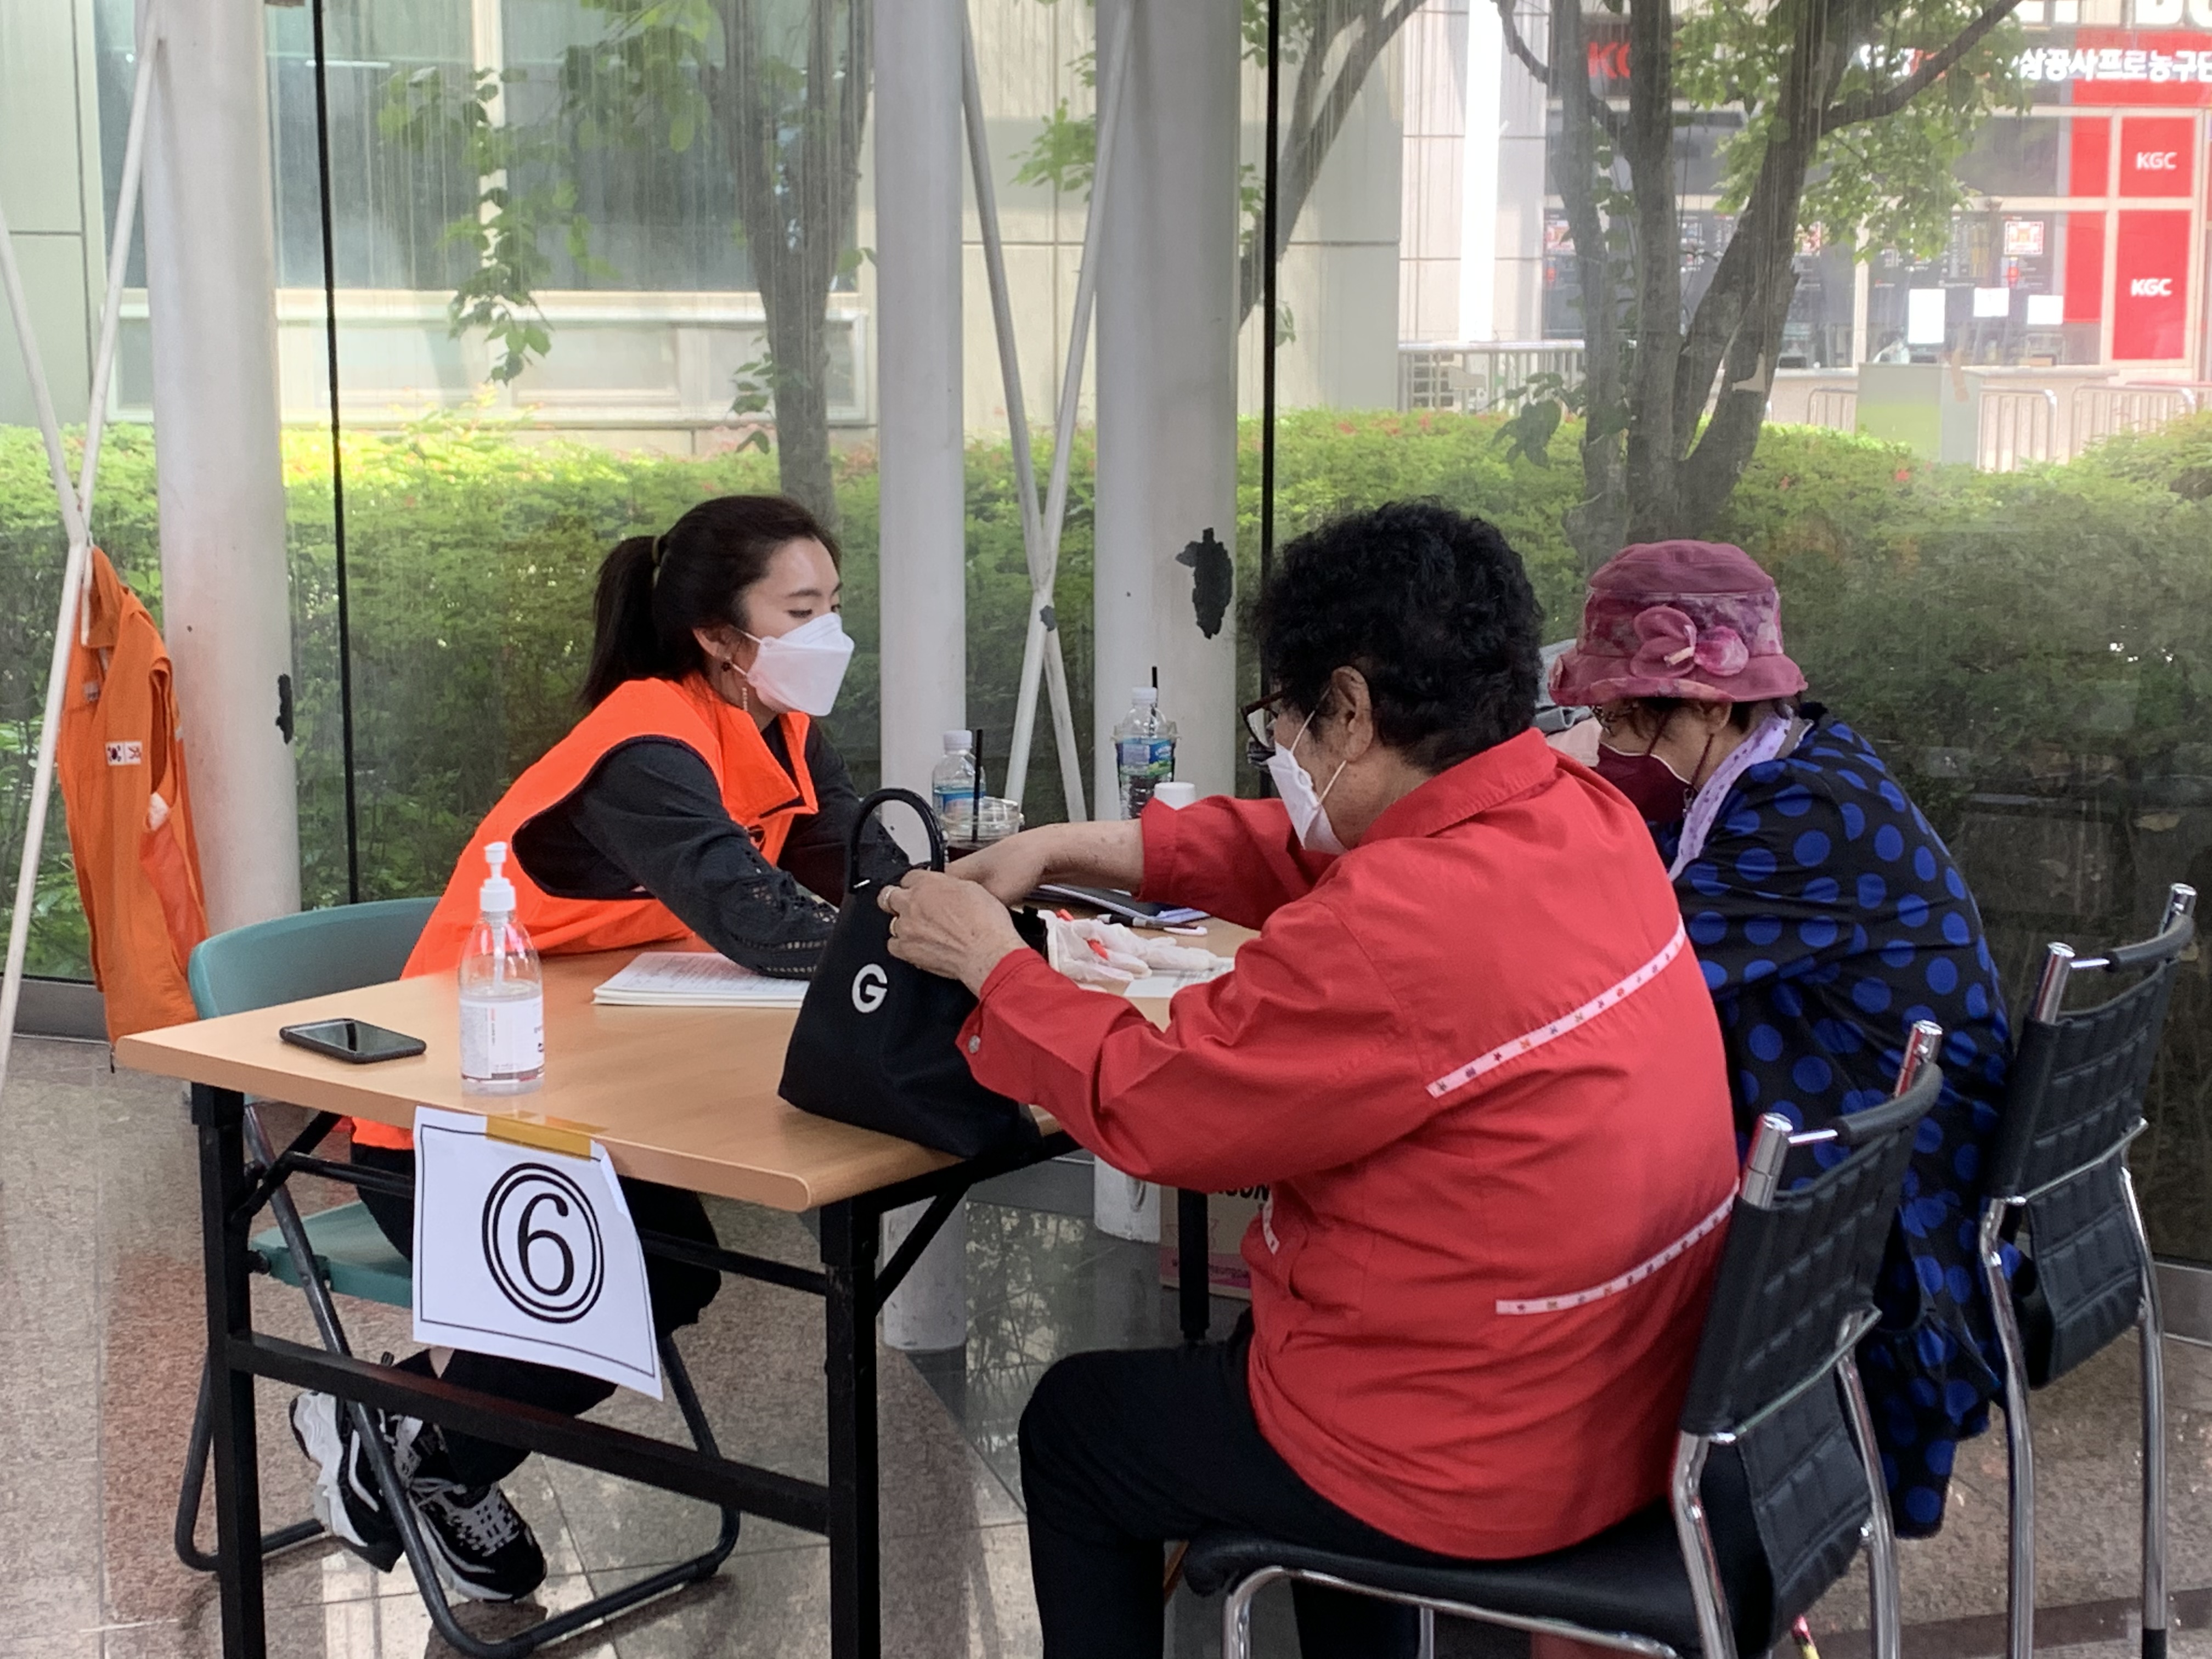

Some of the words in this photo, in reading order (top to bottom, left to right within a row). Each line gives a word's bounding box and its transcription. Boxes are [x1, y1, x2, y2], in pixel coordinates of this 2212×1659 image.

[2136, 151, 2177, 170] KGC
[2130, 278, 2172, 297] KGC
[851, 963, 888, 1014] G
[517, 1193, 574, 1297] 6
